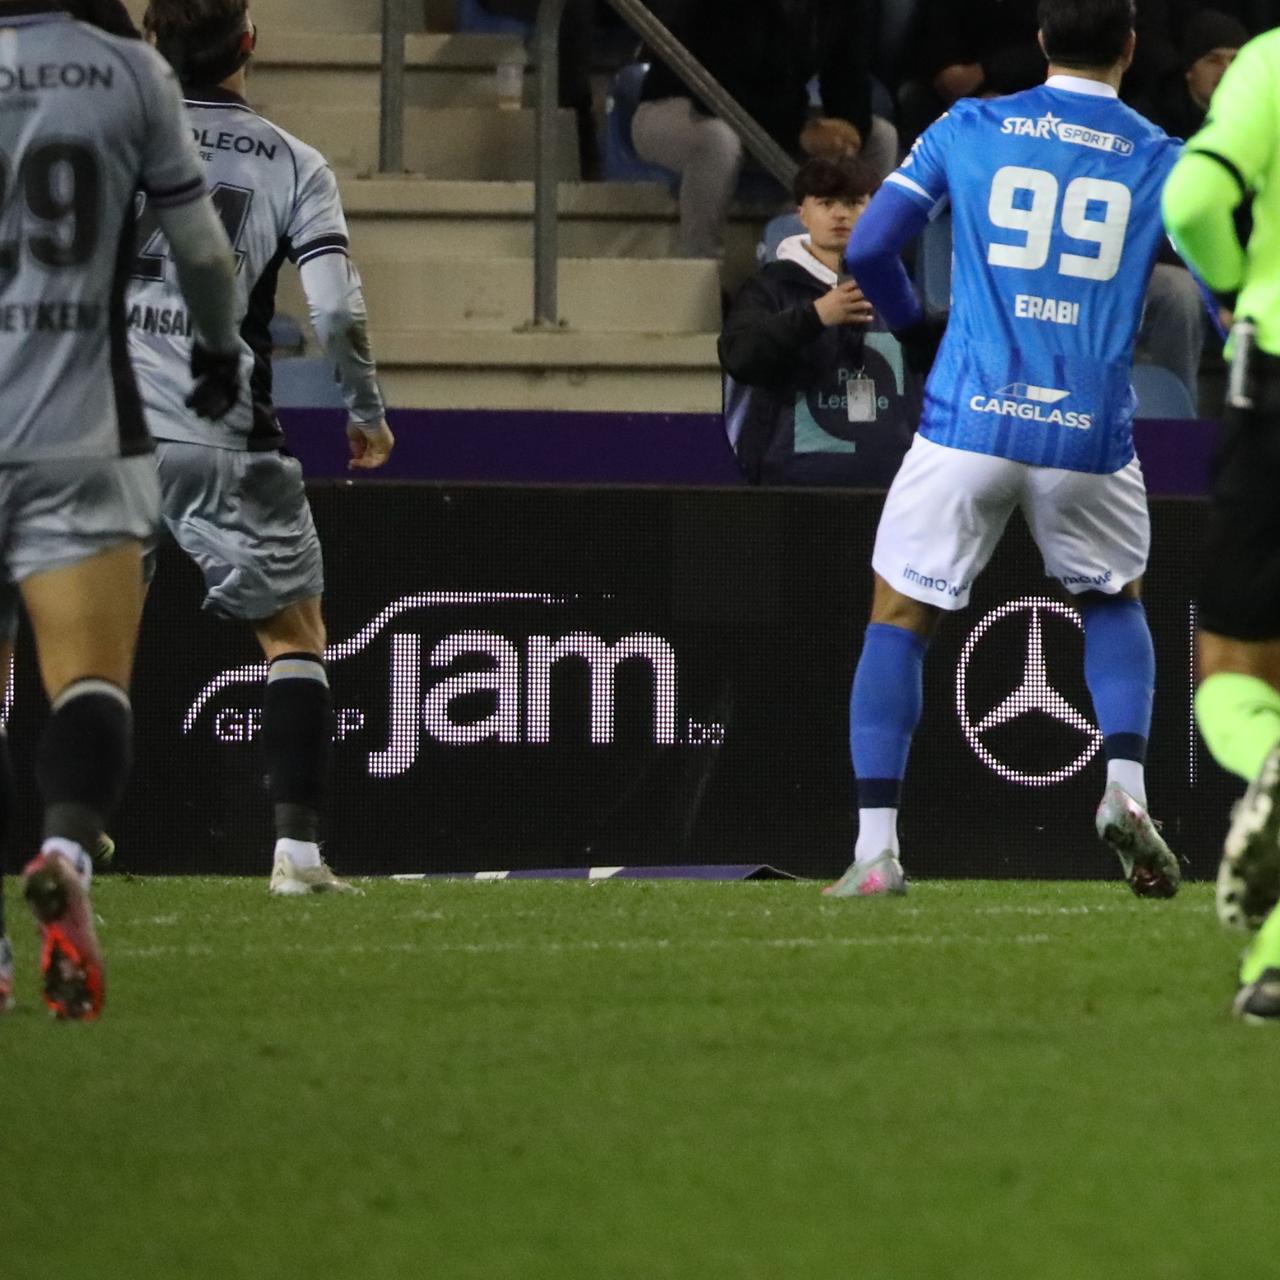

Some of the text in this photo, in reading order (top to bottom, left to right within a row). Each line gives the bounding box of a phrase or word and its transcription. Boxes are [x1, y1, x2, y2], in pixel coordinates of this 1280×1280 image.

[192, 127, 277, 161] LEON
[1001, 115, 1054, 140] STAR
[1063, 127, 1110, 148] SPORT
[0, 140, 101, 268] 9
[988, 165, 1132, 281] 99
[1014, 294, 1080, 325] ERABI
[969, 395, 1091, 429] CARGLASS
[368, 629, 678, 778] jam
